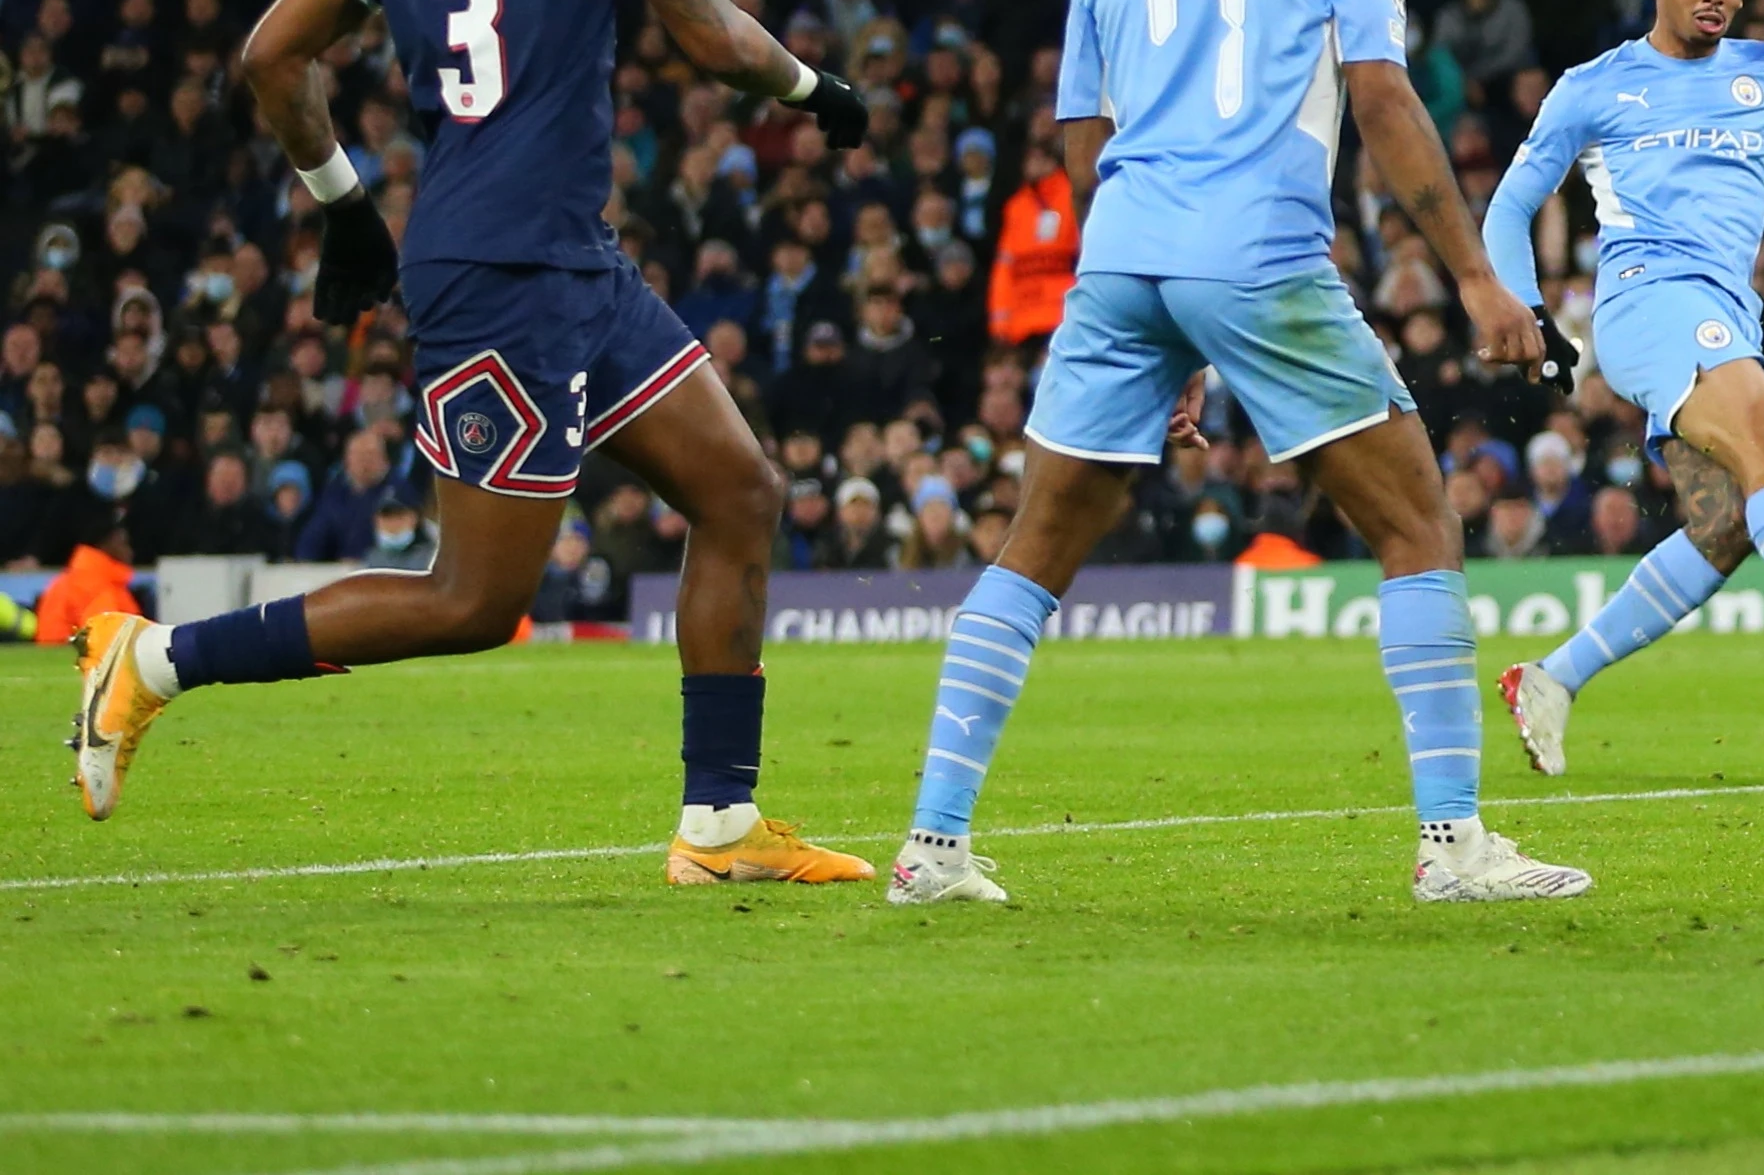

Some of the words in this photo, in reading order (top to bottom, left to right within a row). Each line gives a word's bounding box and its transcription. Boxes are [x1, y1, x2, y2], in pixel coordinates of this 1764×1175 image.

[1632, 128, 1763, 152] ETIHAD
[566, 370, 588, 448] 3
[772, 606, 960, 643] CHAMPI
